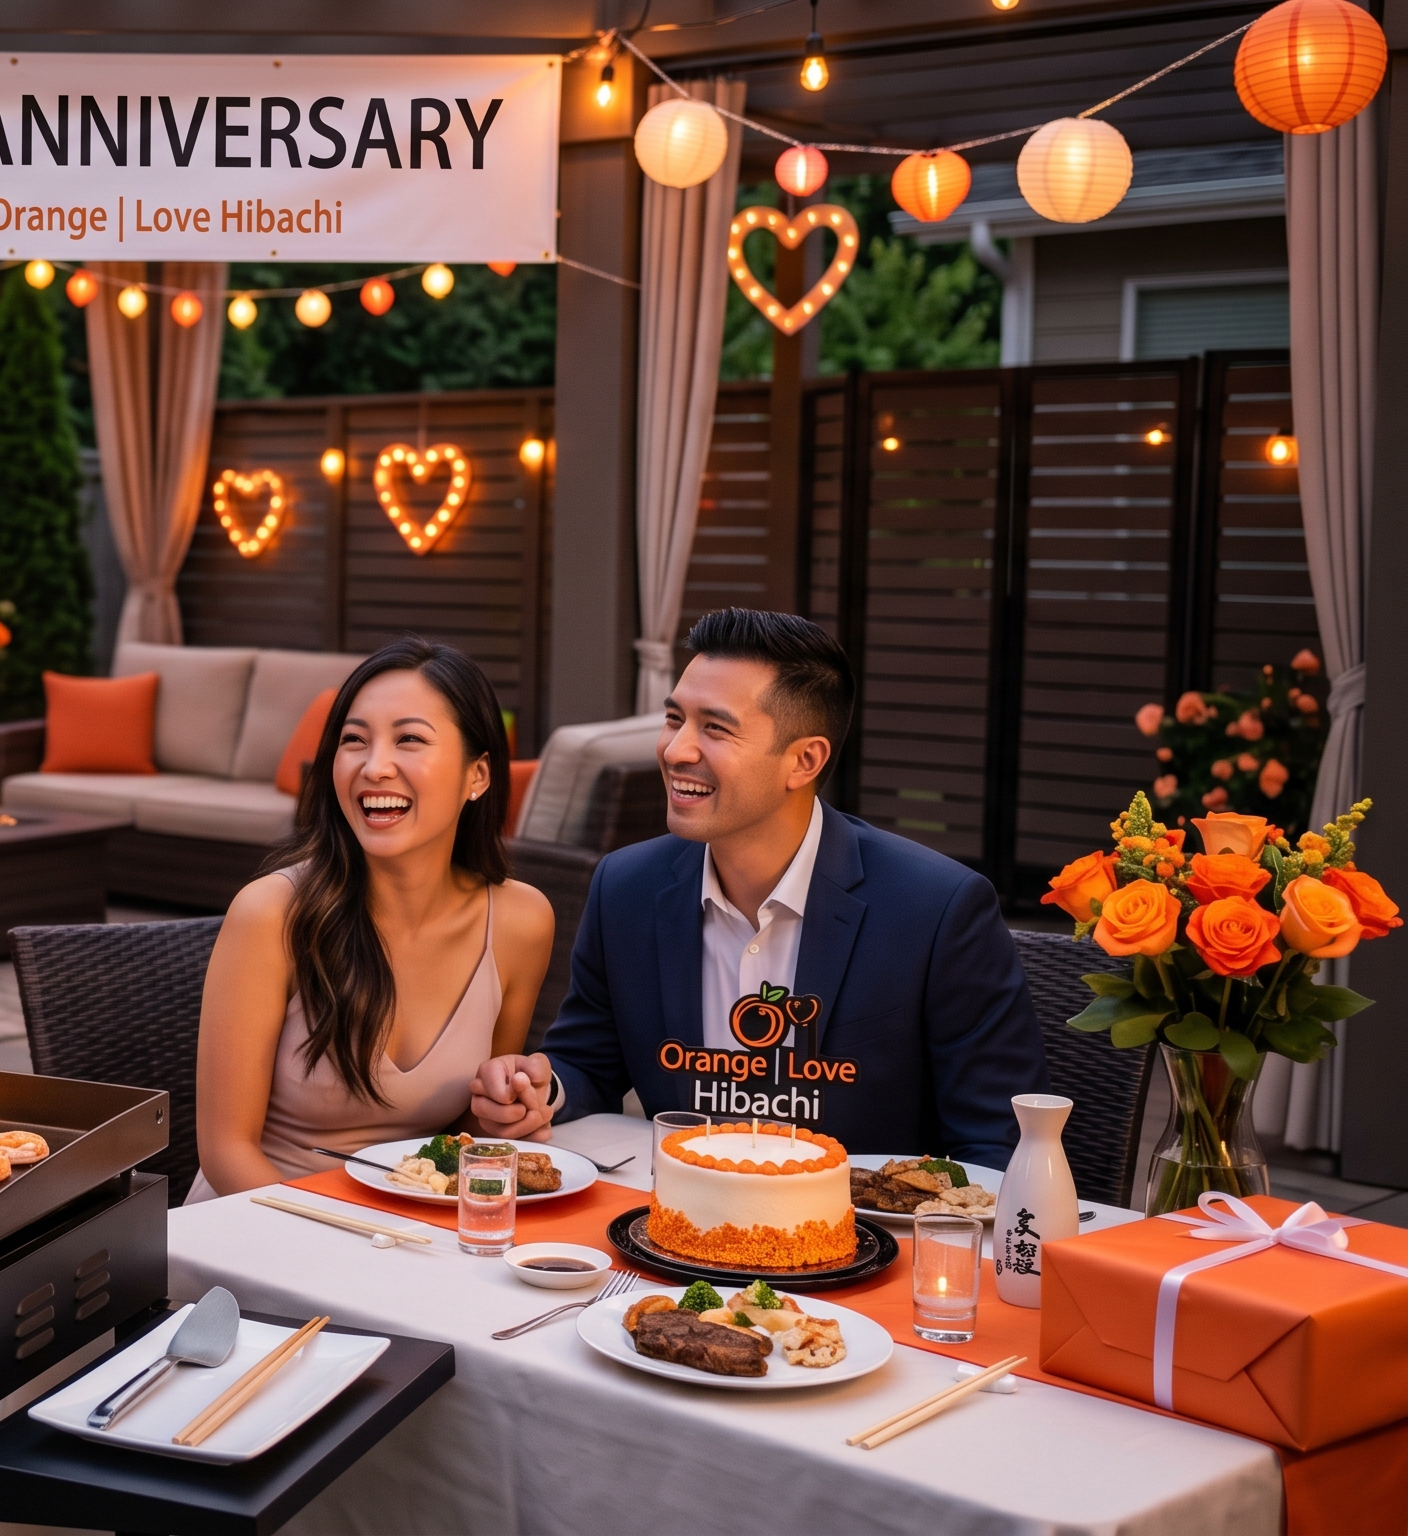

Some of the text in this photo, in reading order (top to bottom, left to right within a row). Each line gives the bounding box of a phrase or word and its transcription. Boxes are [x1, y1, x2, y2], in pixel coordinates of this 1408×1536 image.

[135, 199, 211, 233] Love
[220, 198, 343, 234] Hibachi
[660, 1043, 768, 1082] Orange
[788, 1052, 857, 1083] Love
[694, 1079, 820, 1120] Hibachi
